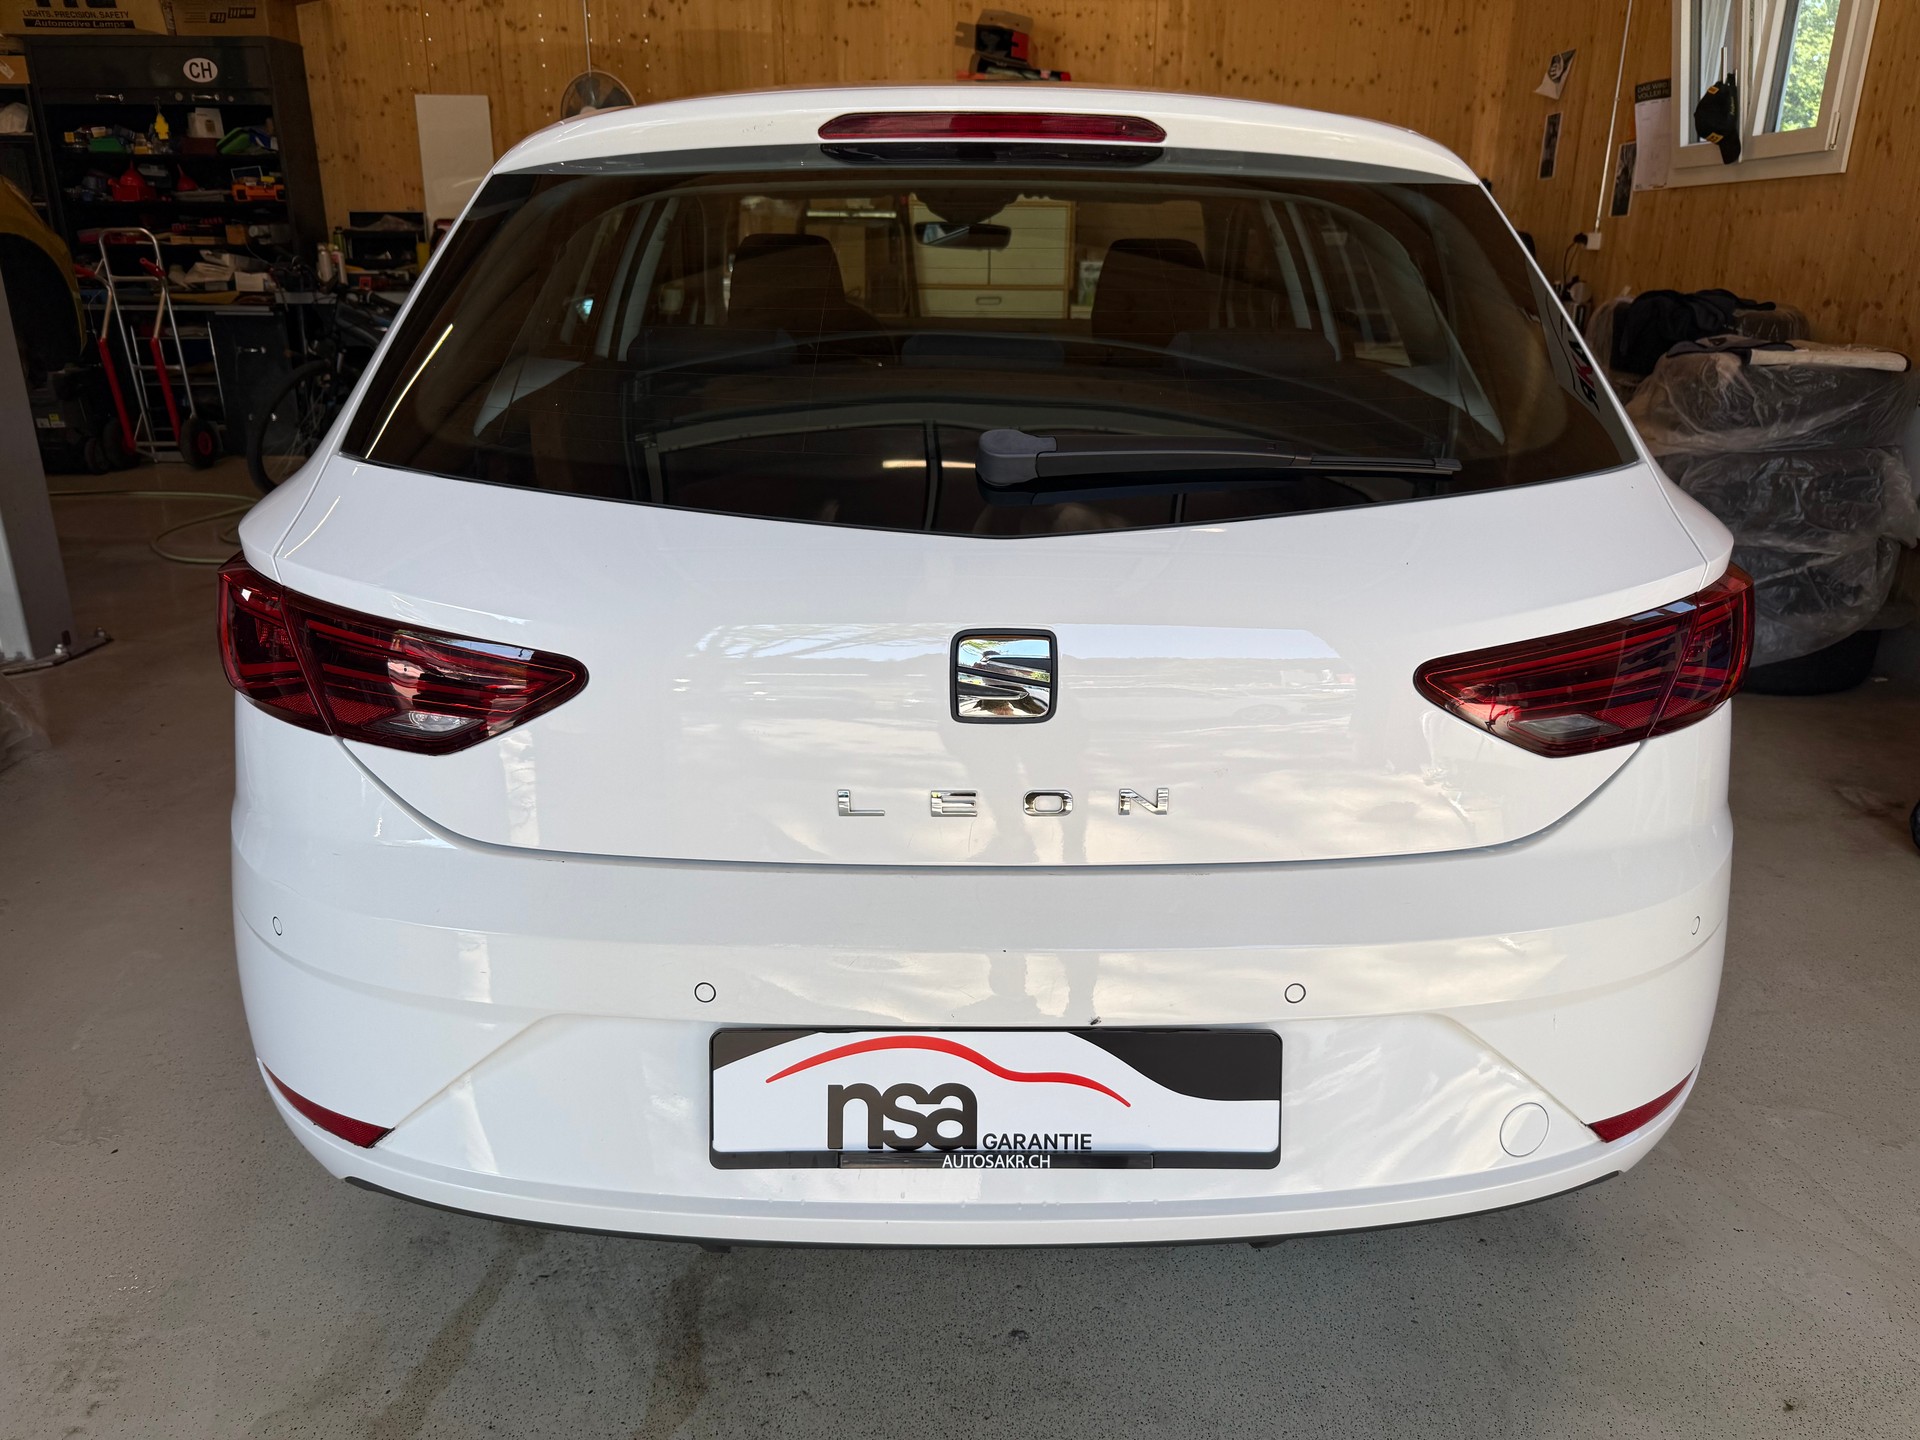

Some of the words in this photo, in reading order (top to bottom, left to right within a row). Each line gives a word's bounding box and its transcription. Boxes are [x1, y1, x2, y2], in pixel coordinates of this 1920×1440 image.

[34, 19, 91, 27] Automotive
[93, 20, 126, 28] Lamps
[99, 11, 130, 19] SAFETY
[189, 61, 212, 79] CH
[837, 788, 1169, 817] LEON
[827, 1082, 978, 1151] nsa
[982, 1133, 1092, 1151] GARANTIE
[942, 1154, 1051, 1169] AUTOSAKR.CH
